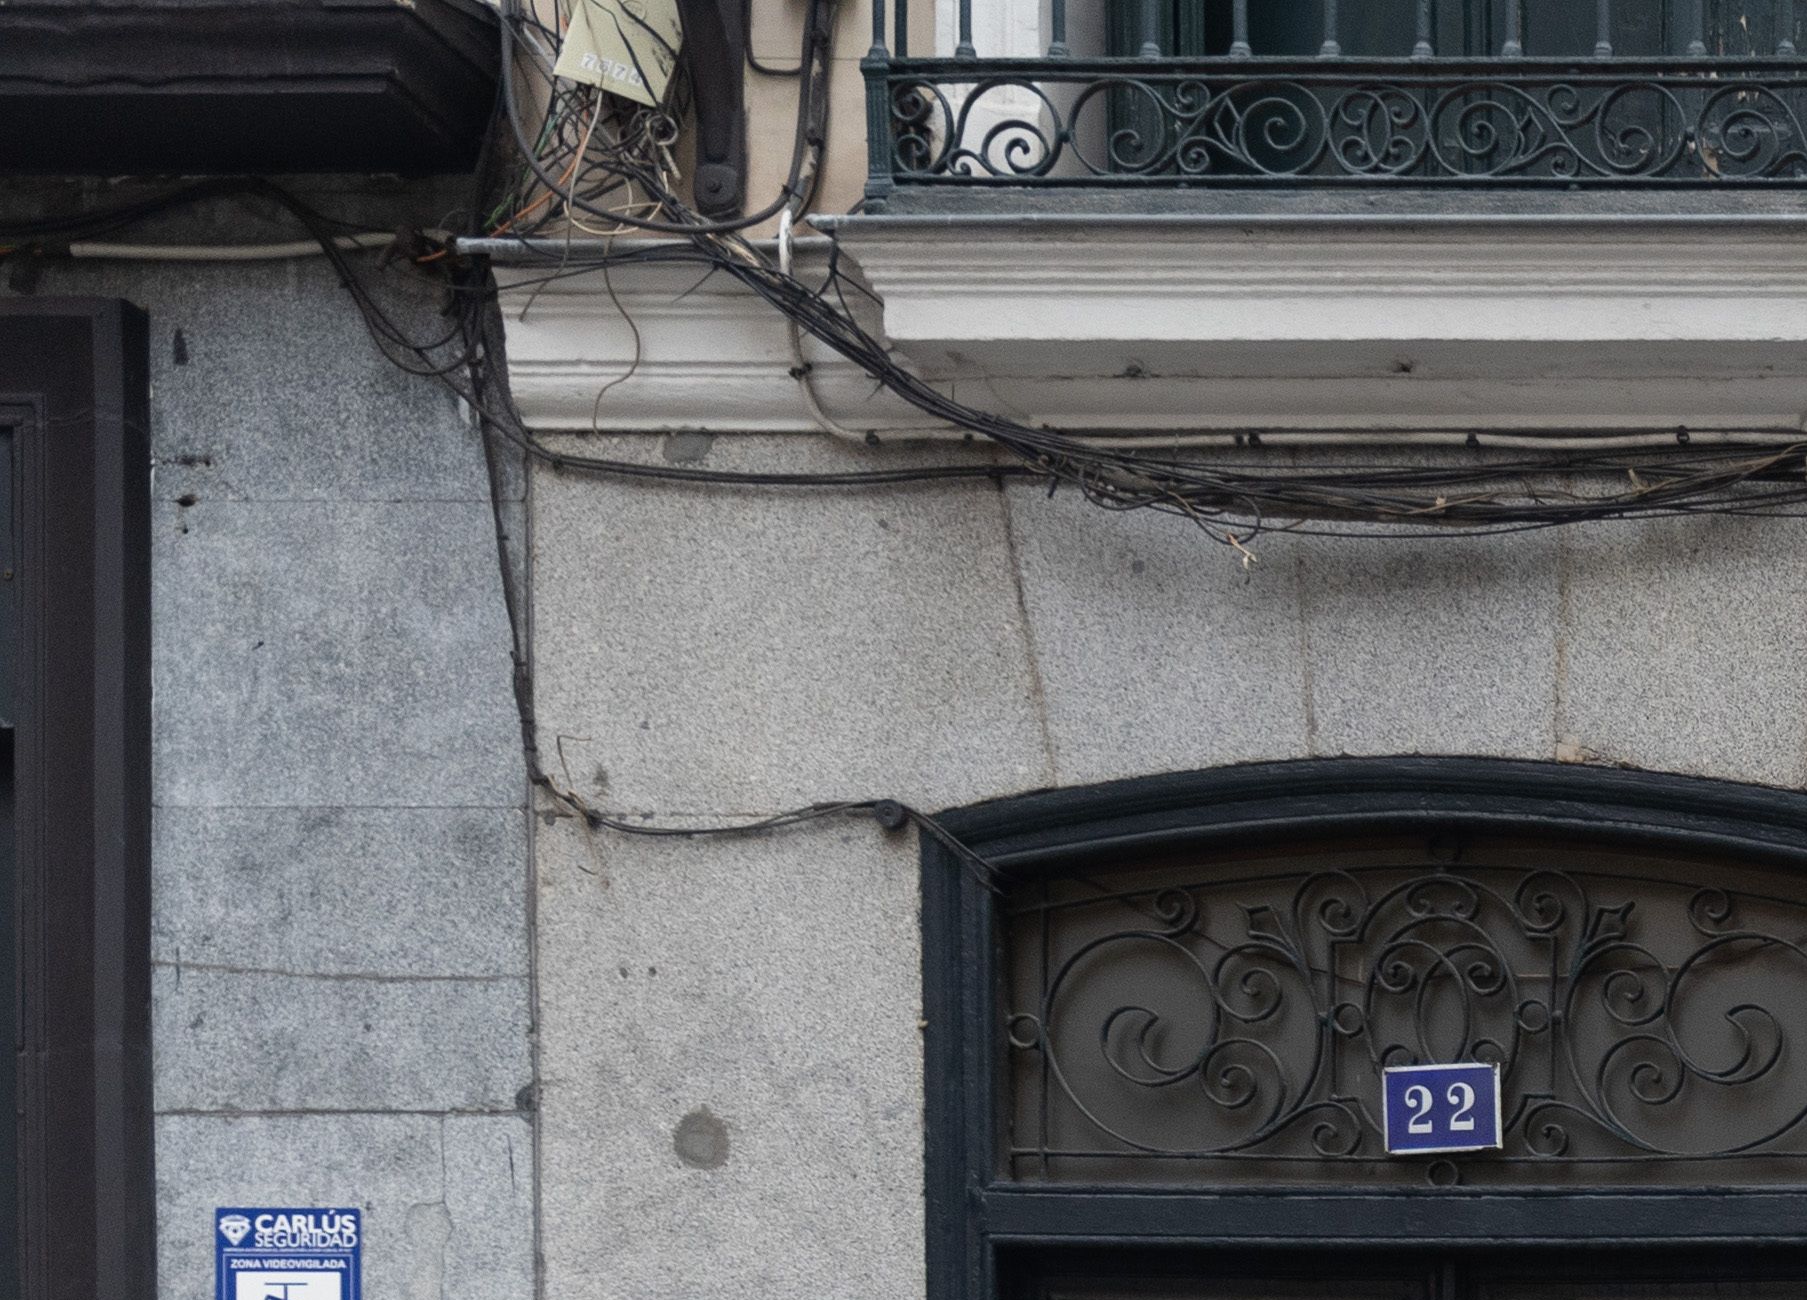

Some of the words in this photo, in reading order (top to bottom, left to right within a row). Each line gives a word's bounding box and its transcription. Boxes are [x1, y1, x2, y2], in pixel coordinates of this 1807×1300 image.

[1403, 1082, 1477, 1135] 22
[255, 1209, 356, 1233] CARLÚS
[255, 1232, 357, 1248] SEGURIDAD
[231, 1259, 262, 1269] ZONA
[263, 1259, 346, 1269] VIDEOVIGILADA
